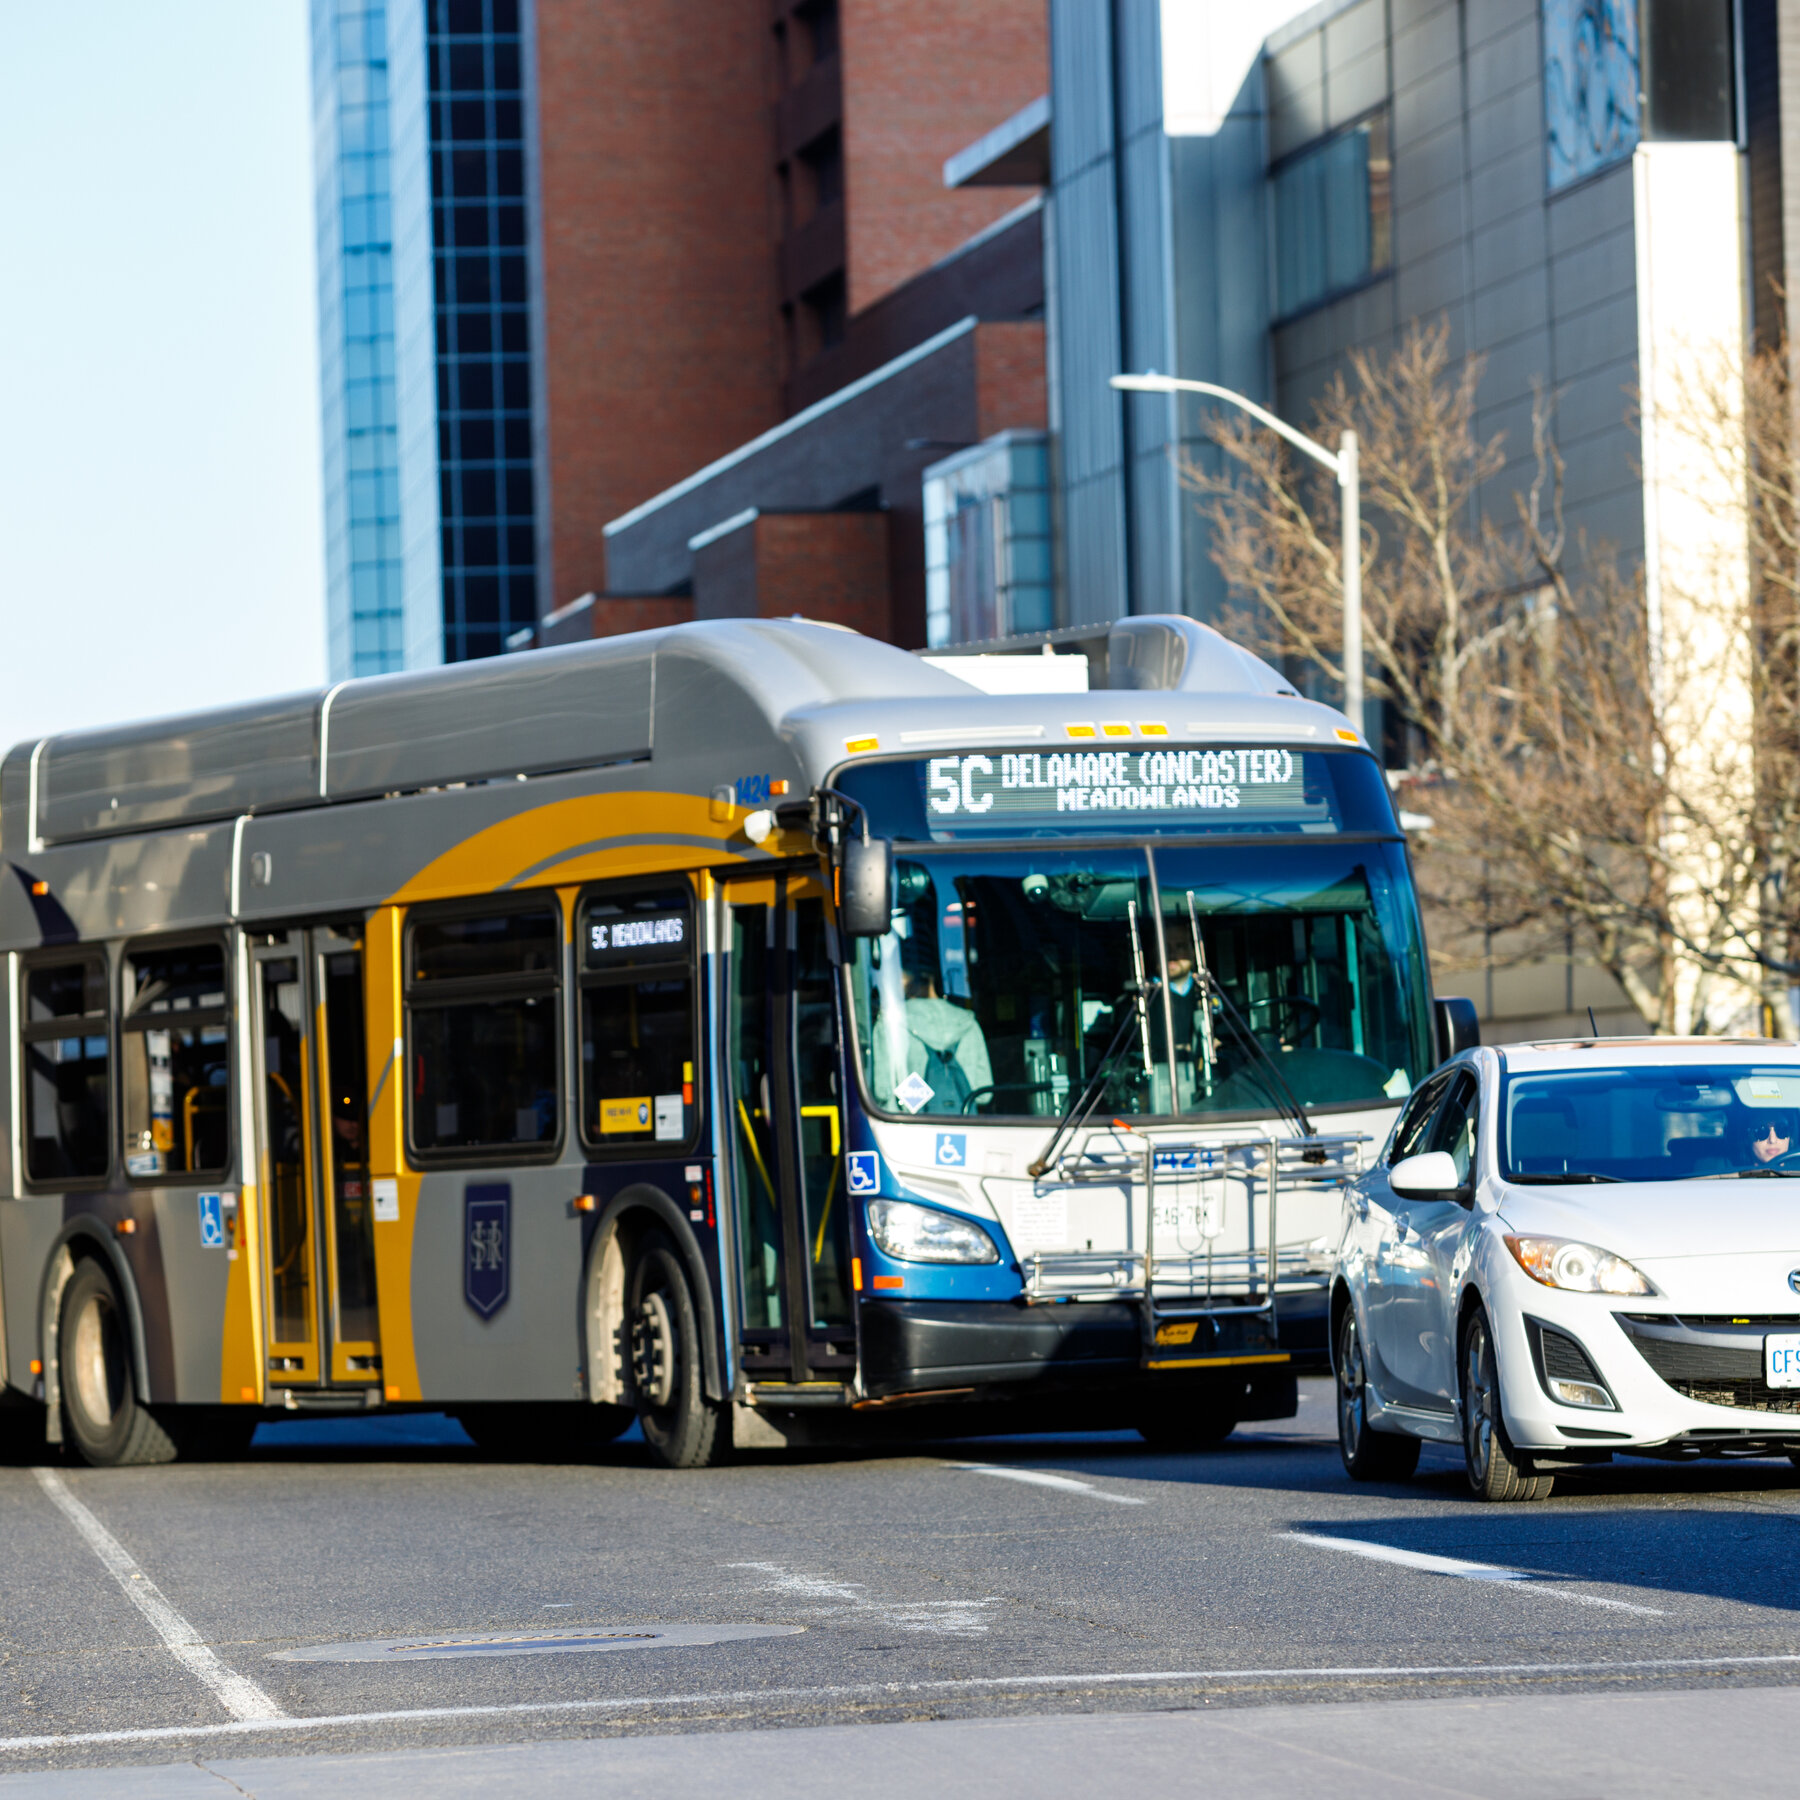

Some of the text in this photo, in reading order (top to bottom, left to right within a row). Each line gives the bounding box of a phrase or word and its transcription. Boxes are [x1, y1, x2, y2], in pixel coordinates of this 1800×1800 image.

[736, 774, 770, 804] 1424
[930, 749, 1293, 813] 5C DELAWARE (ANCASTER)
[1057, 785, 1240, 811] MEADOWLANDS
[592, 925, 608, 949] 5C
